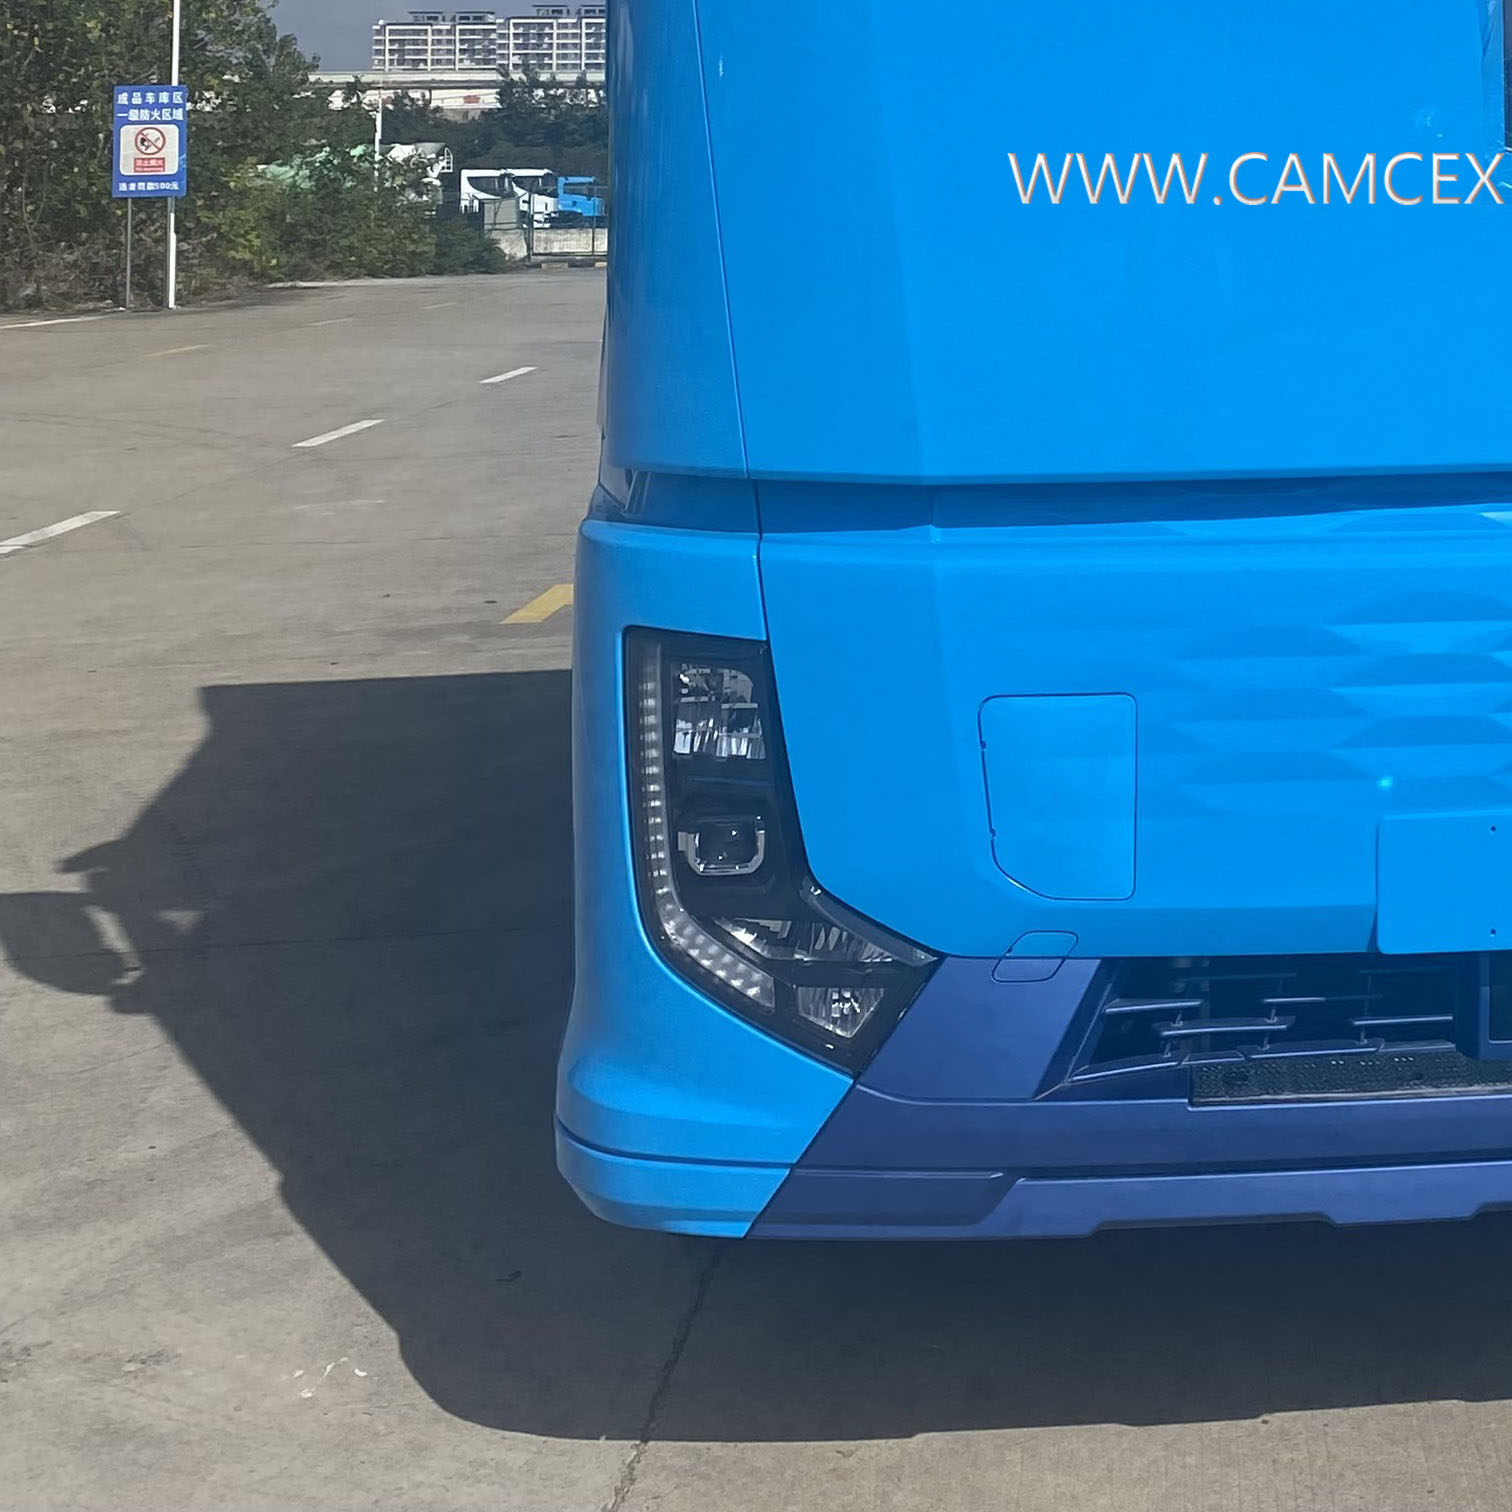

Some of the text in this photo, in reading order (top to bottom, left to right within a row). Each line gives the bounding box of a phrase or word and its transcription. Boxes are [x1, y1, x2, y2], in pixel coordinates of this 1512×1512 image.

[117, 91, 184, 105] 成品车库区
[116, 107, 184, 121] 一级防火区域
